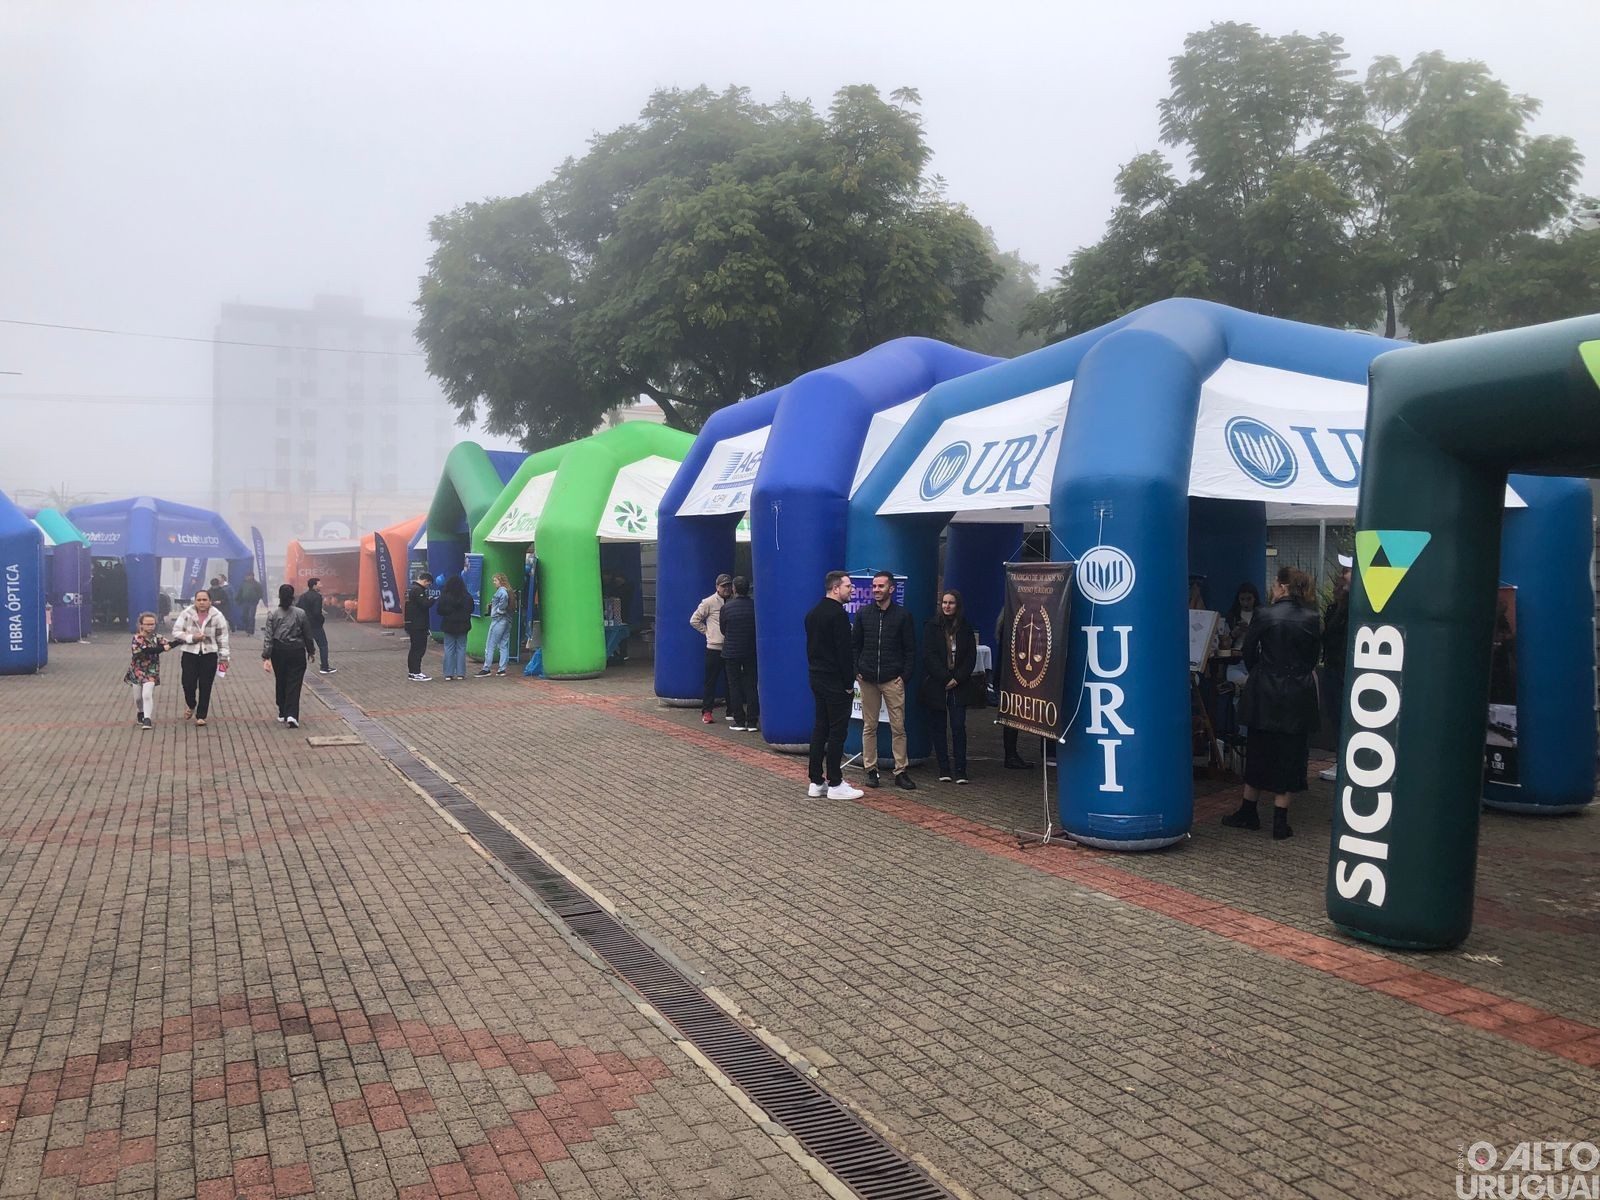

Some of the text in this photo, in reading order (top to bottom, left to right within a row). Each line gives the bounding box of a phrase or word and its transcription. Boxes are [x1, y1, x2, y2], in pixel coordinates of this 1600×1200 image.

[962, 425, 1059, 496] URI
[5, 564, 24, 651] FIBRA ÓPTICA
[999, 690, 1057, 727] DIREITO
[1081, 626, 1135, 792] URI
[1336, 625, 1405, 907] SICOOB
